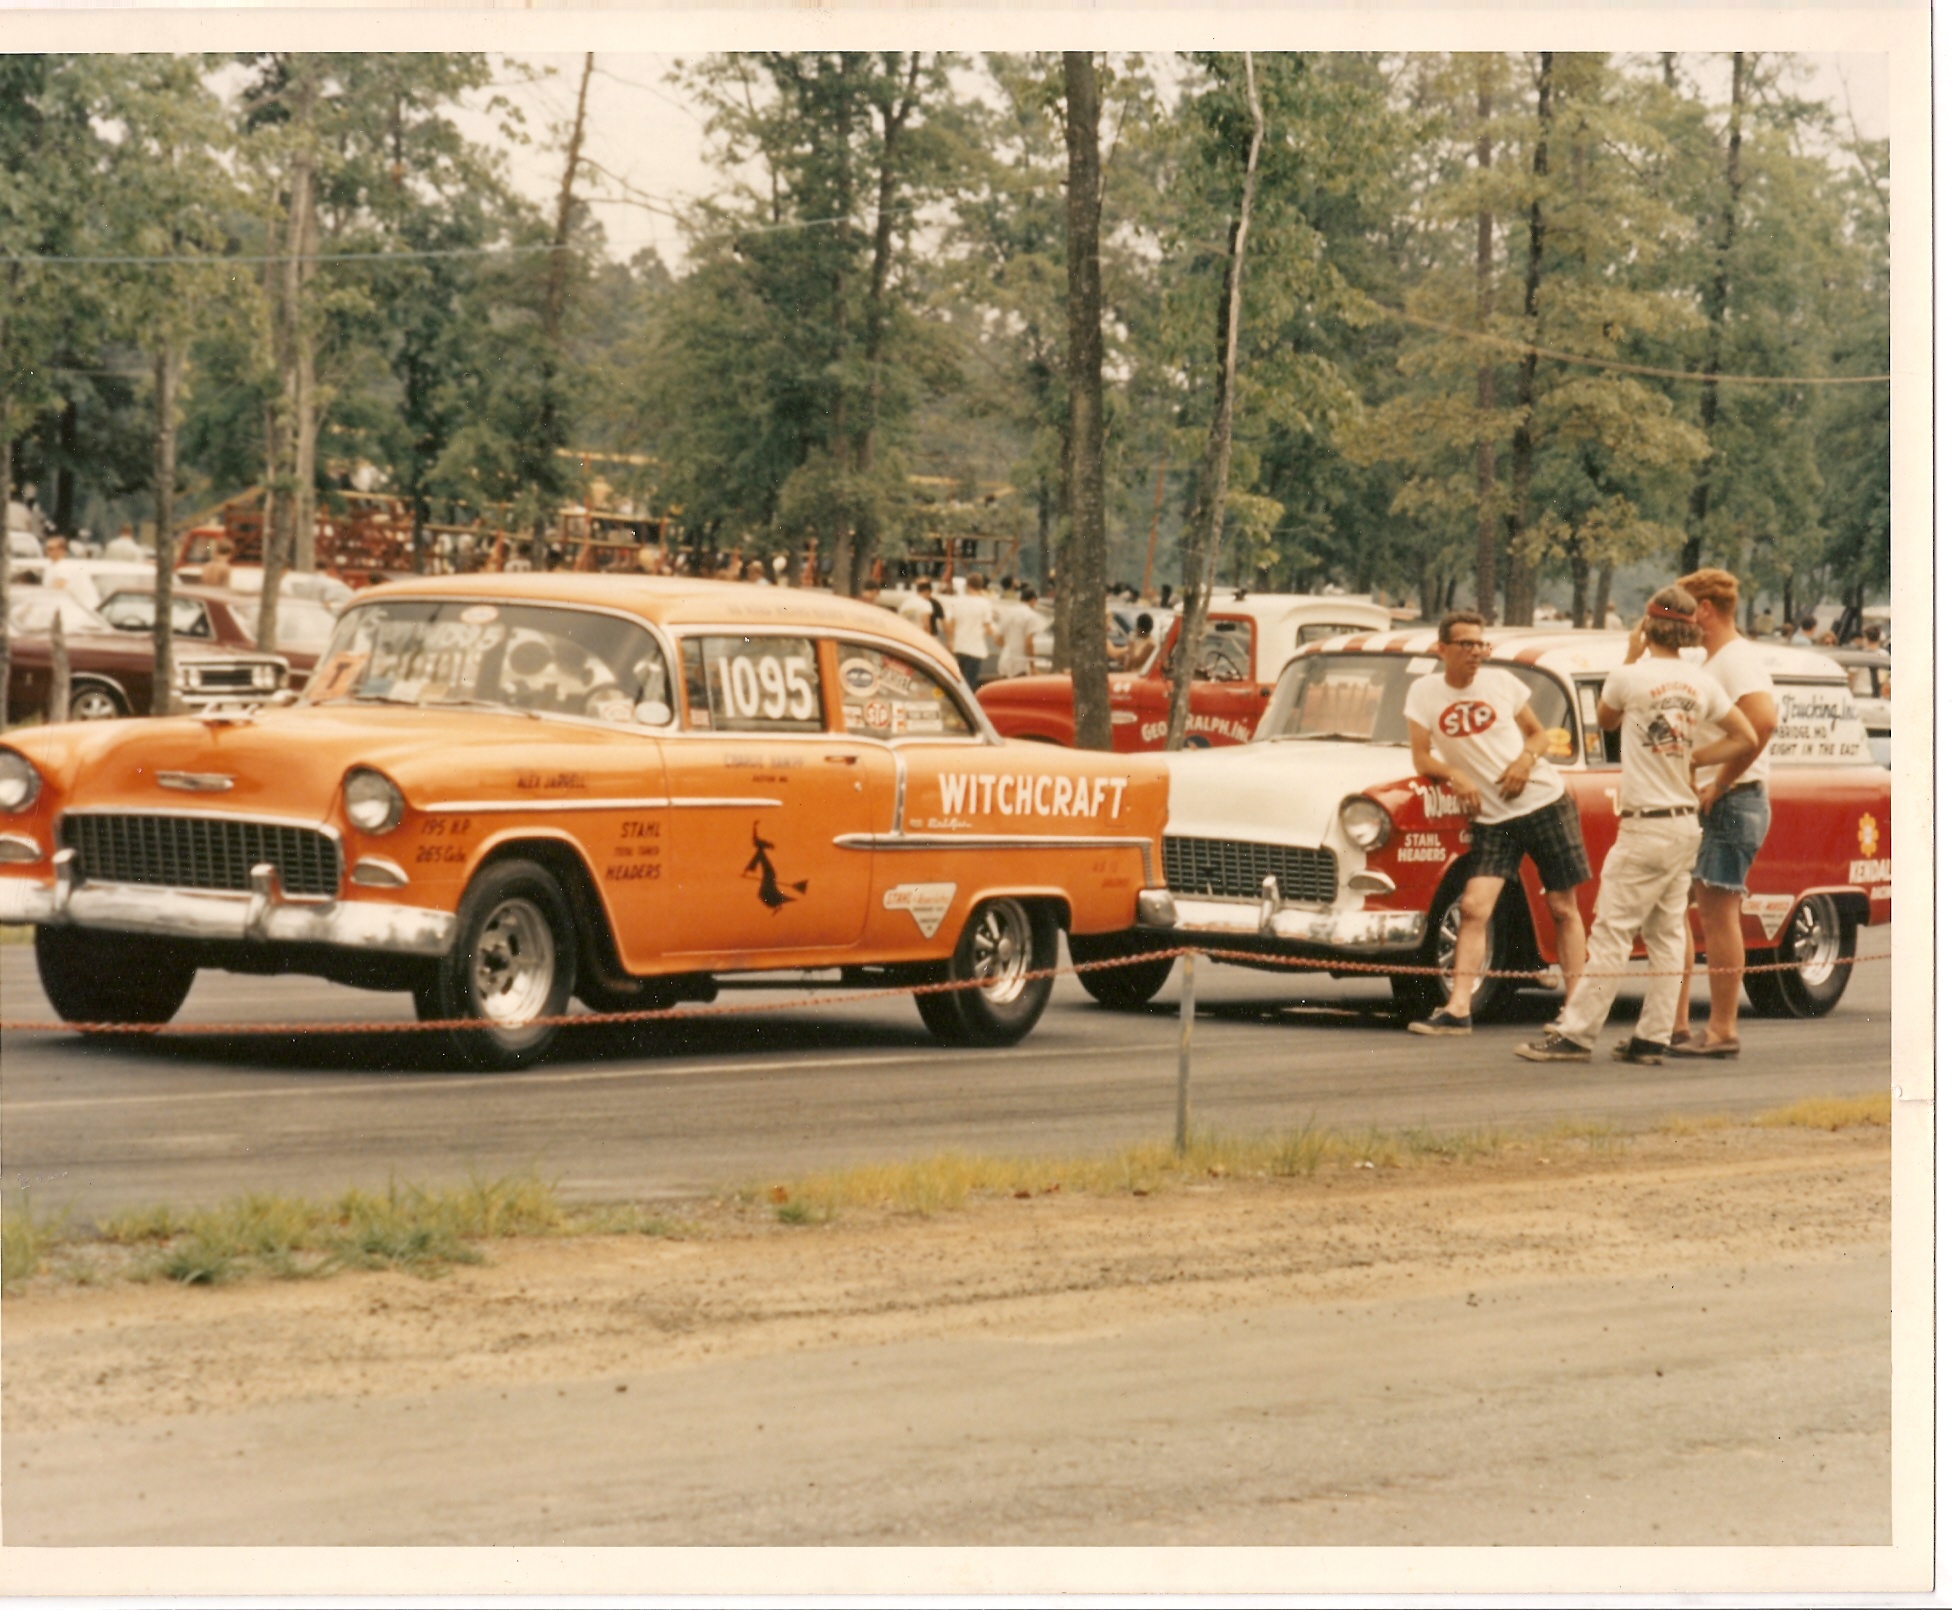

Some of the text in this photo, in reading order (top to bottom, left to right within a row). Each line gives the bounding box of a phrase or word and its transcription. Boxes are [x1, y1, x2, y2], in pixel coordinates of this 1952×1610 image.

[719, 655, 813, 721] 1095
[1444, 703, 1493, 735] STP
[938, 773, 1128, 819] WITCHCRAFT
[620, 821, 661, 838] STAHL
[1404, 833, 1442, 847] STAHL
[1396, 847, 1446, 862] HEADERS
[605, 863, 662, 881] HEADERS
